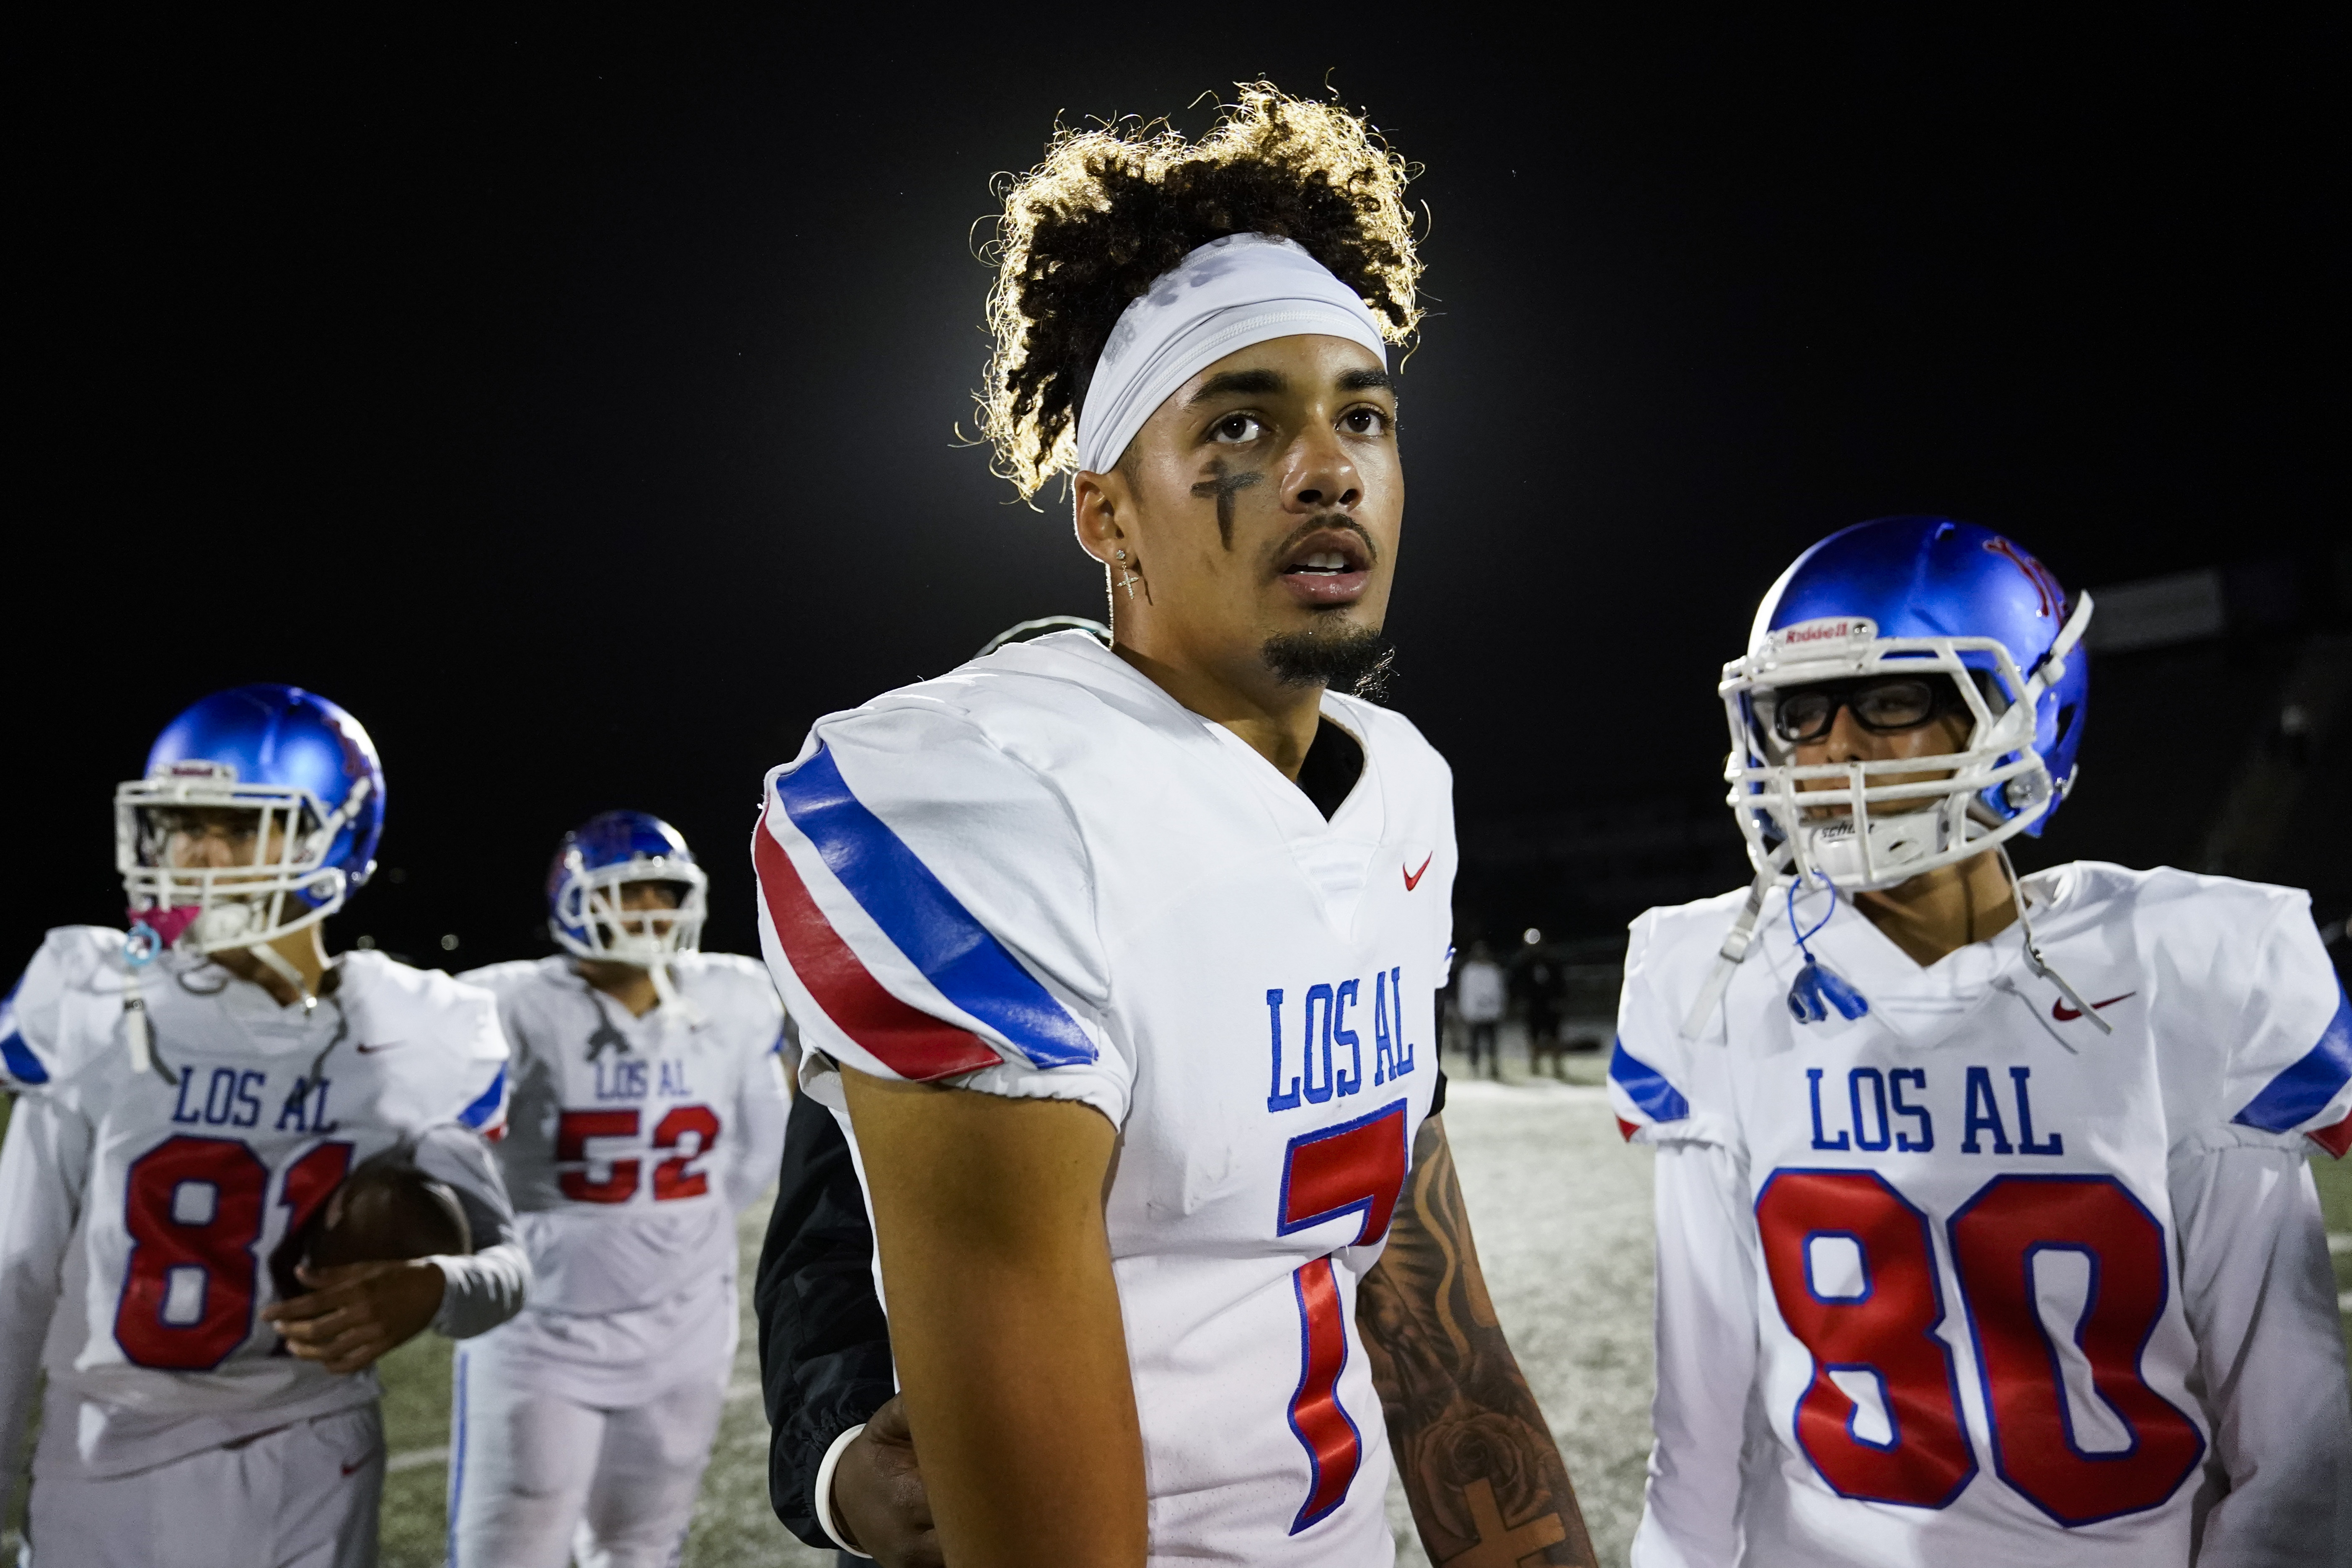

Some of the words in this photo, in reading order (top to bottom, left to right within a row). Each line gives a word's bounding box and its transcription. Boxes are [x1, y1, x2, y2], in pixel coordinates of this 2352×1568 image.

[1785, 621, 1847, 644] Riddell
[595, 1059, 649, 1101] LOS
[658, 1059, 693, 1096] AL
[1266, 979, 1361, 1112] LOS
[1375, 966, 1414, 1086] AL
[173, 1064, 266, 1128] LOS
[276, 1076, 338, 1133] AL
[1806, 1067, 1934, 1152] LOS
[1961, 1066, 2064, 1155] AL
[557, 1103, 721, 1203] 52
[113, 1134, 357, 1372] 8
[1277, 1098, 1408, 1536] 7
[1753, 1167, 2207, 1529] 80
